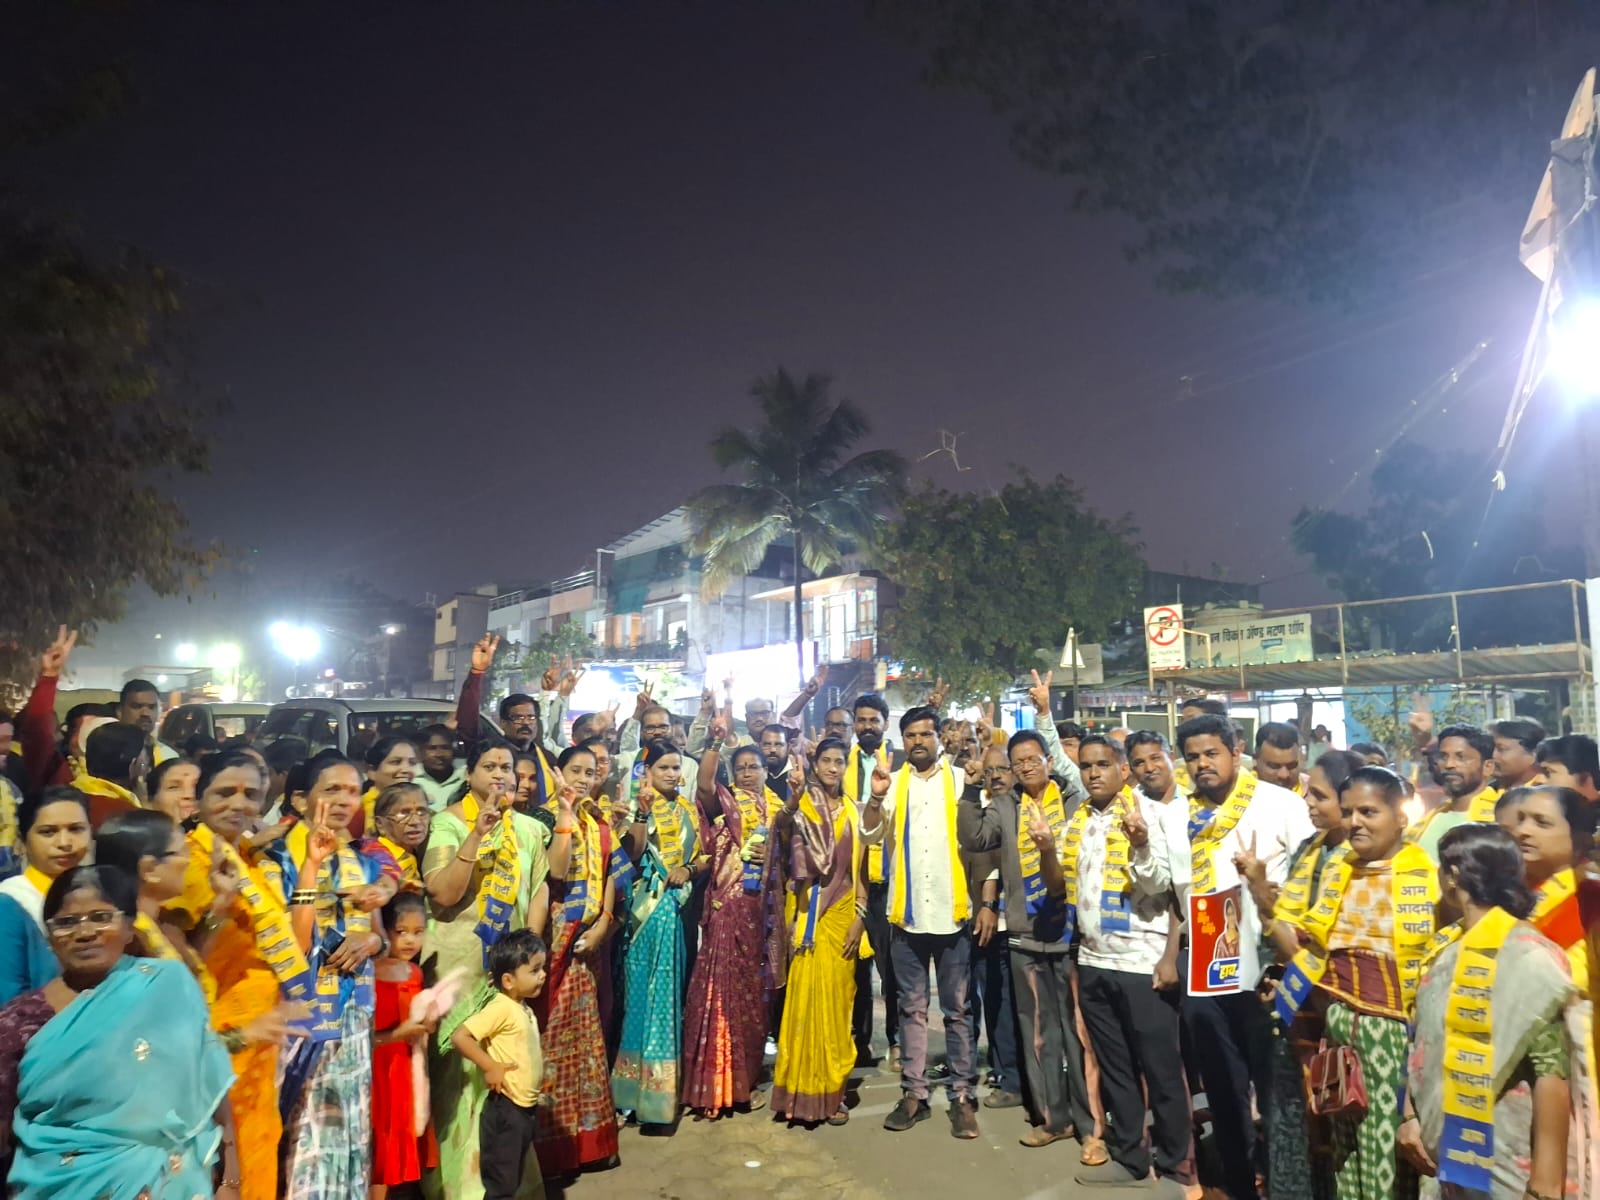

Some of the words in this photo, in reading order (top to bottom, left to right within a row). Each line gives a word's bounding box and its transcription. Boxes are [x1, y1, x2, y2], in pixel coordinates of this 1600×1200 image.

[1401, 885, 1428, 897] आम
[1396, 901, 1435, 915] आदमी
[1402, 920, 1431, 934] पार्टी
[1463, 965, 1490, 978] आम
[1456, 1006, 1487, 1024] पार्टी
[1456, 1049, 1486, 1065] आम
